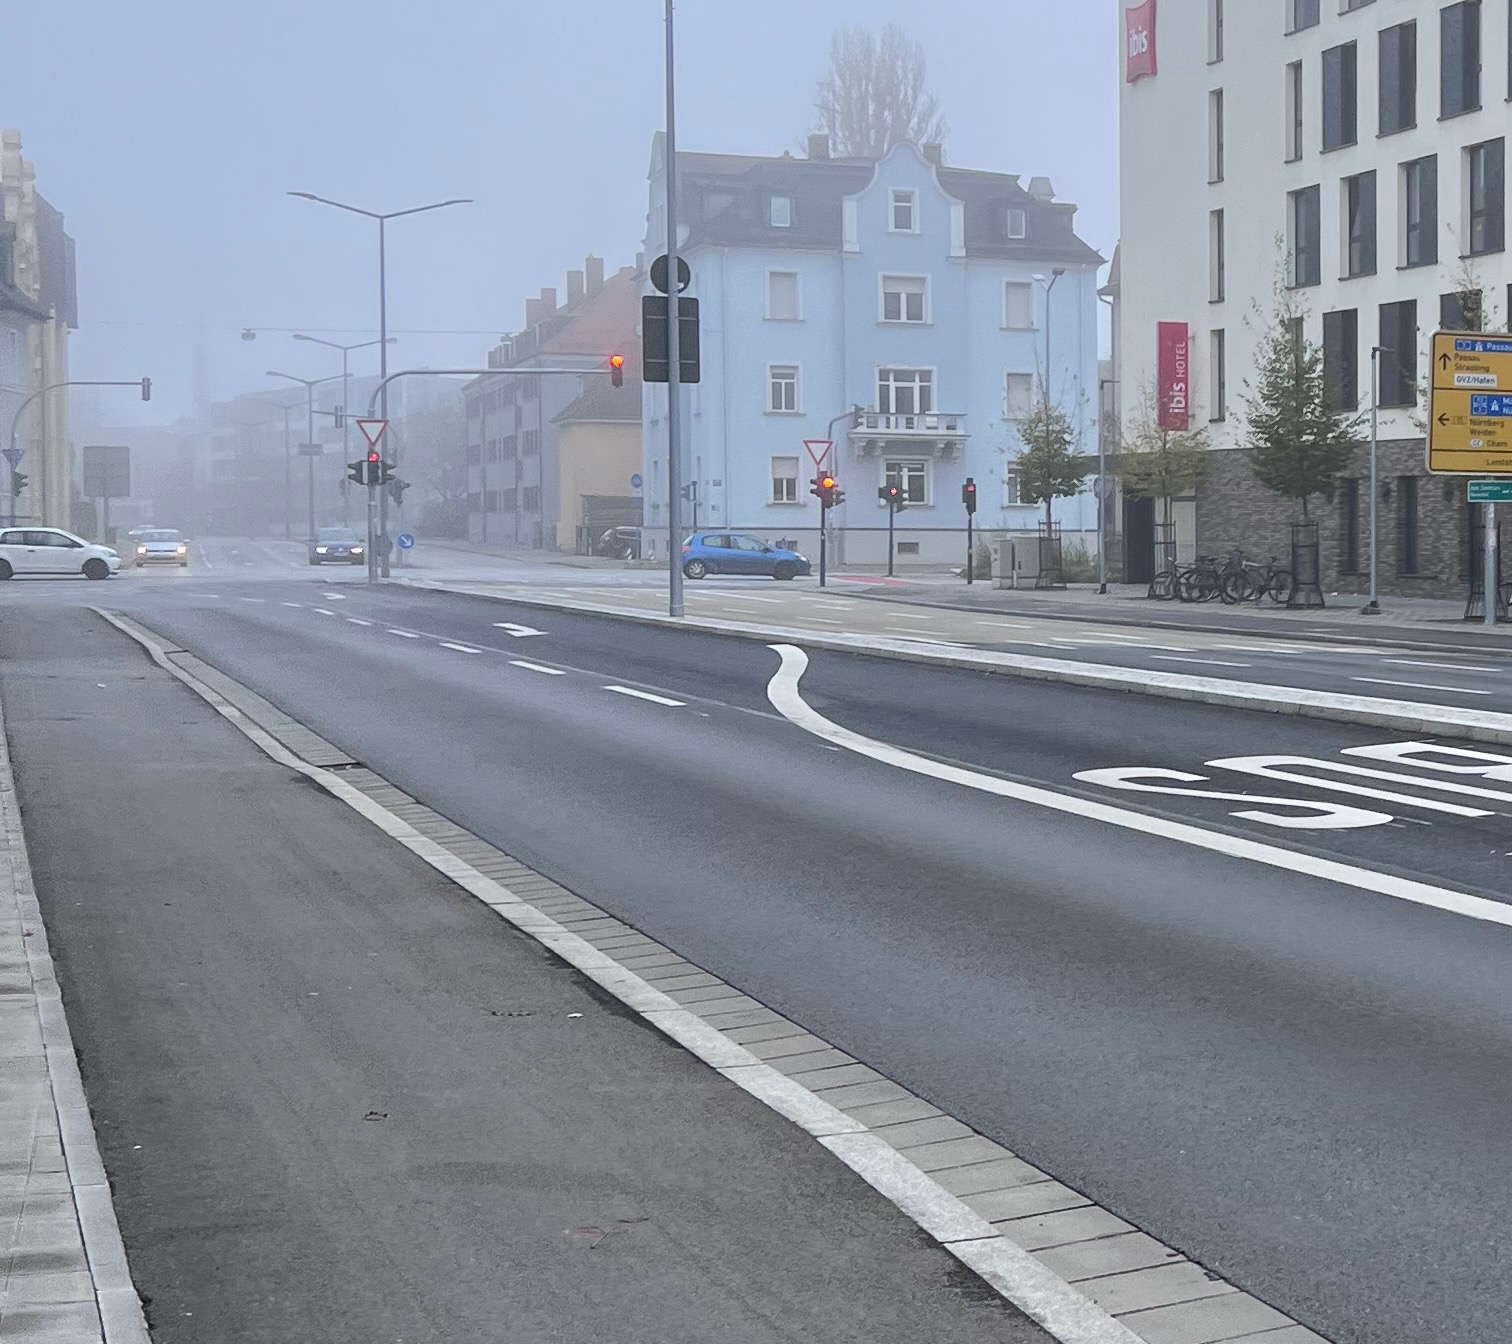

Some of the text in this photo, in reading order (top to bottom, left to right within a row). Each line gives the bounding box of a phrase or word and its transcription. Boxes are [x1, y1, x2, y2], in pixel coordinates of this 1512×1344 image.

[1129, 25, 1148, 57] ibis
[1169, 341, 1186, 413] ibis HOTEL
